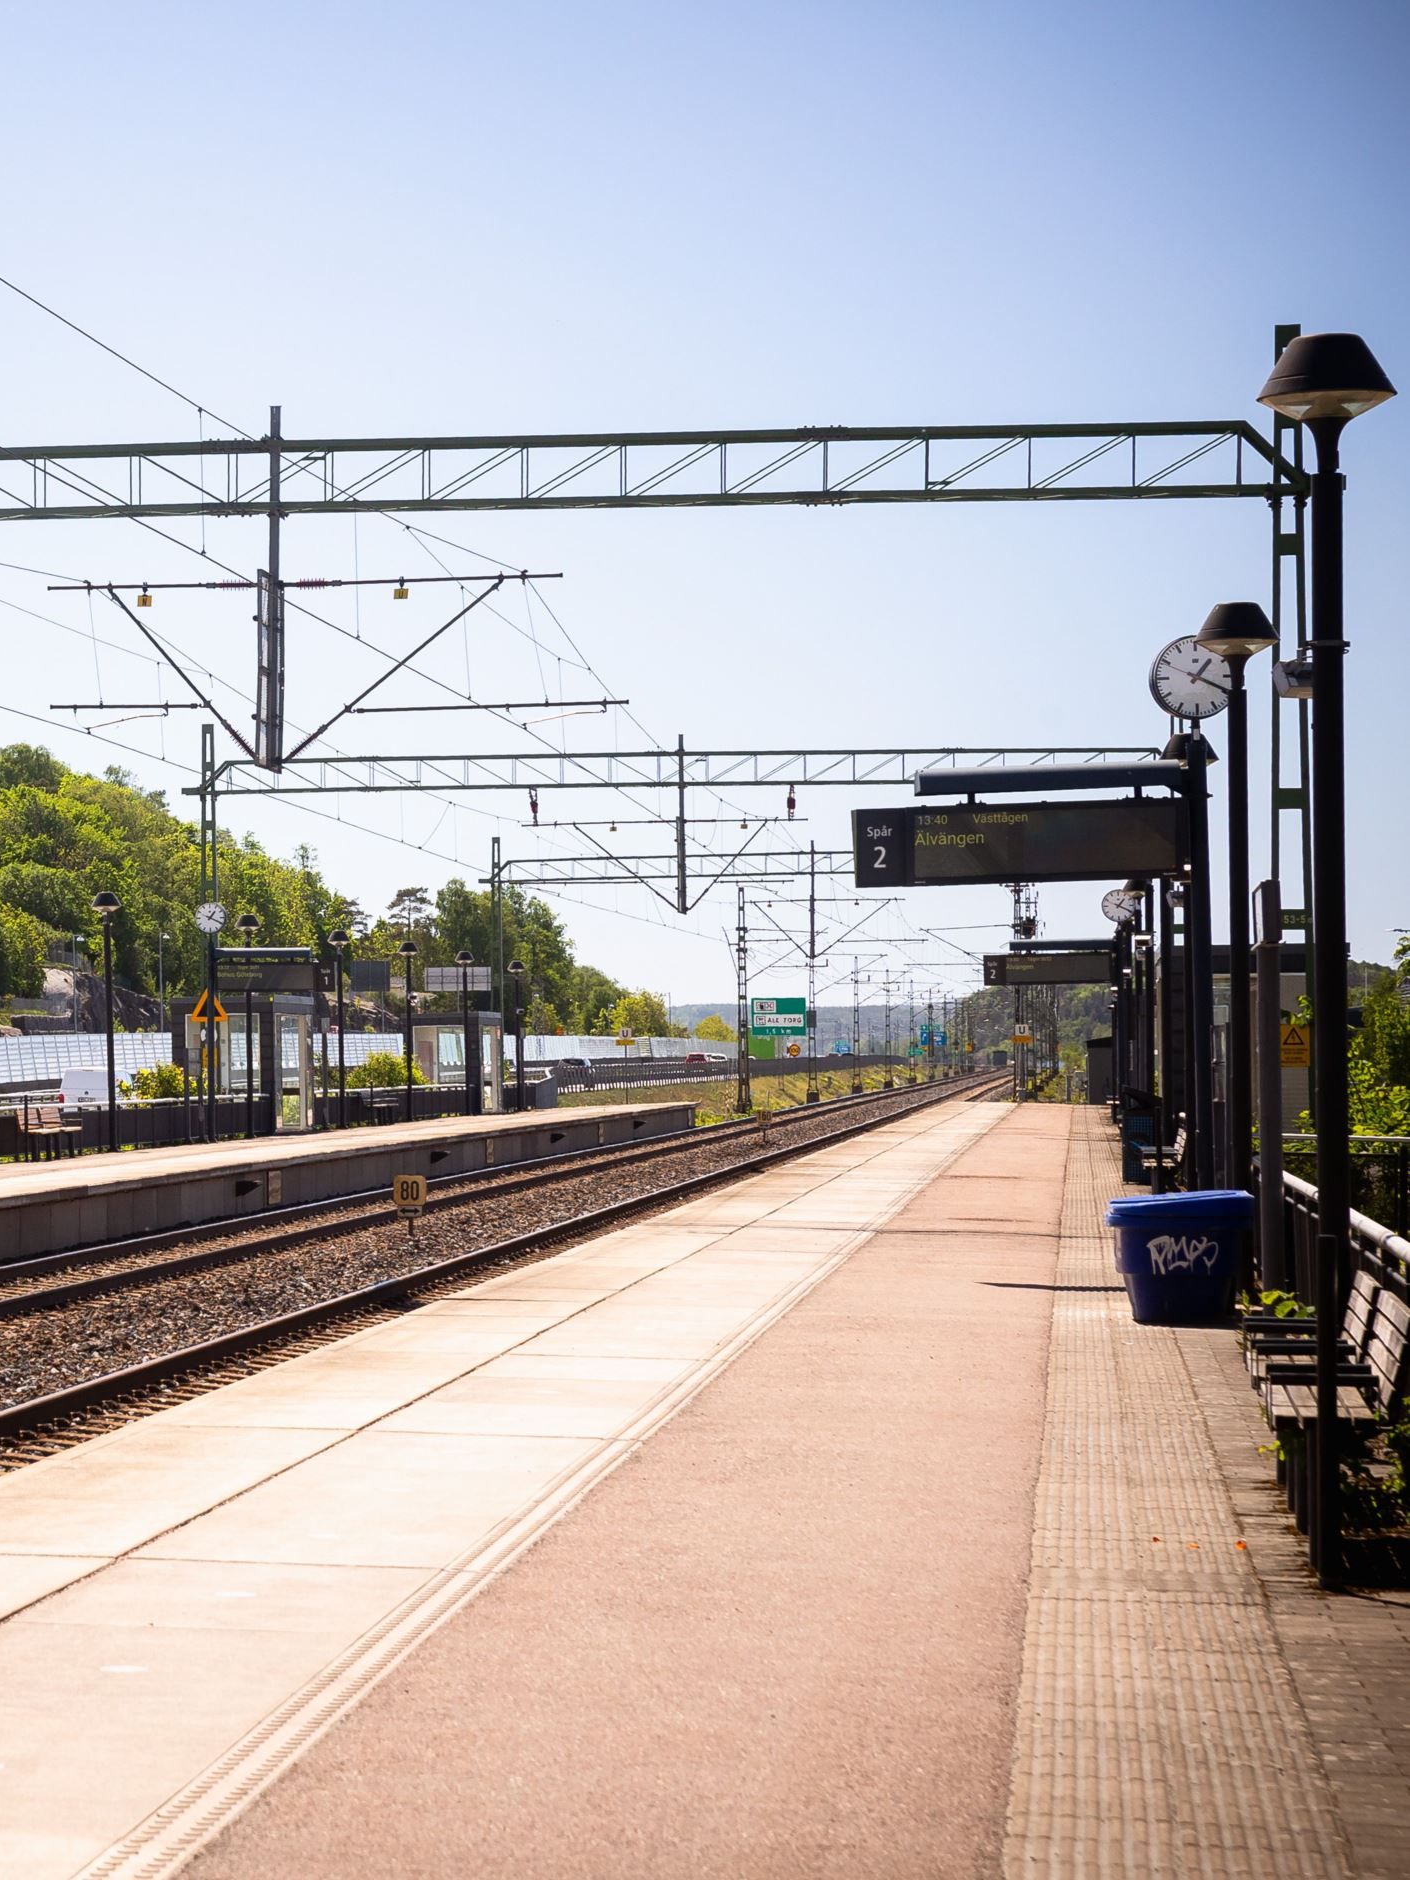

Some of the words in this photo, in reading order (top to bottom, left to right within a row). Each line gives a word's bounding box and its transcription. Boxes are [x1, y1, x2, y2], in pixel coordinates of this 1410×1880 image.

[917, 814, 948, 826] 13:40
[972, 811, 1029, 825] Västtågen
[866, 825, 893, 839] Spår
[914, 830, 985, 848] Älvängen
[873, 846, 887, 868] 2
[990, 969, 996, 979] 2
[622, 1029, 629, 1038] U
[1019, 1025, 1026, 1034] U
[401, 1181, 419, 1200] 80
